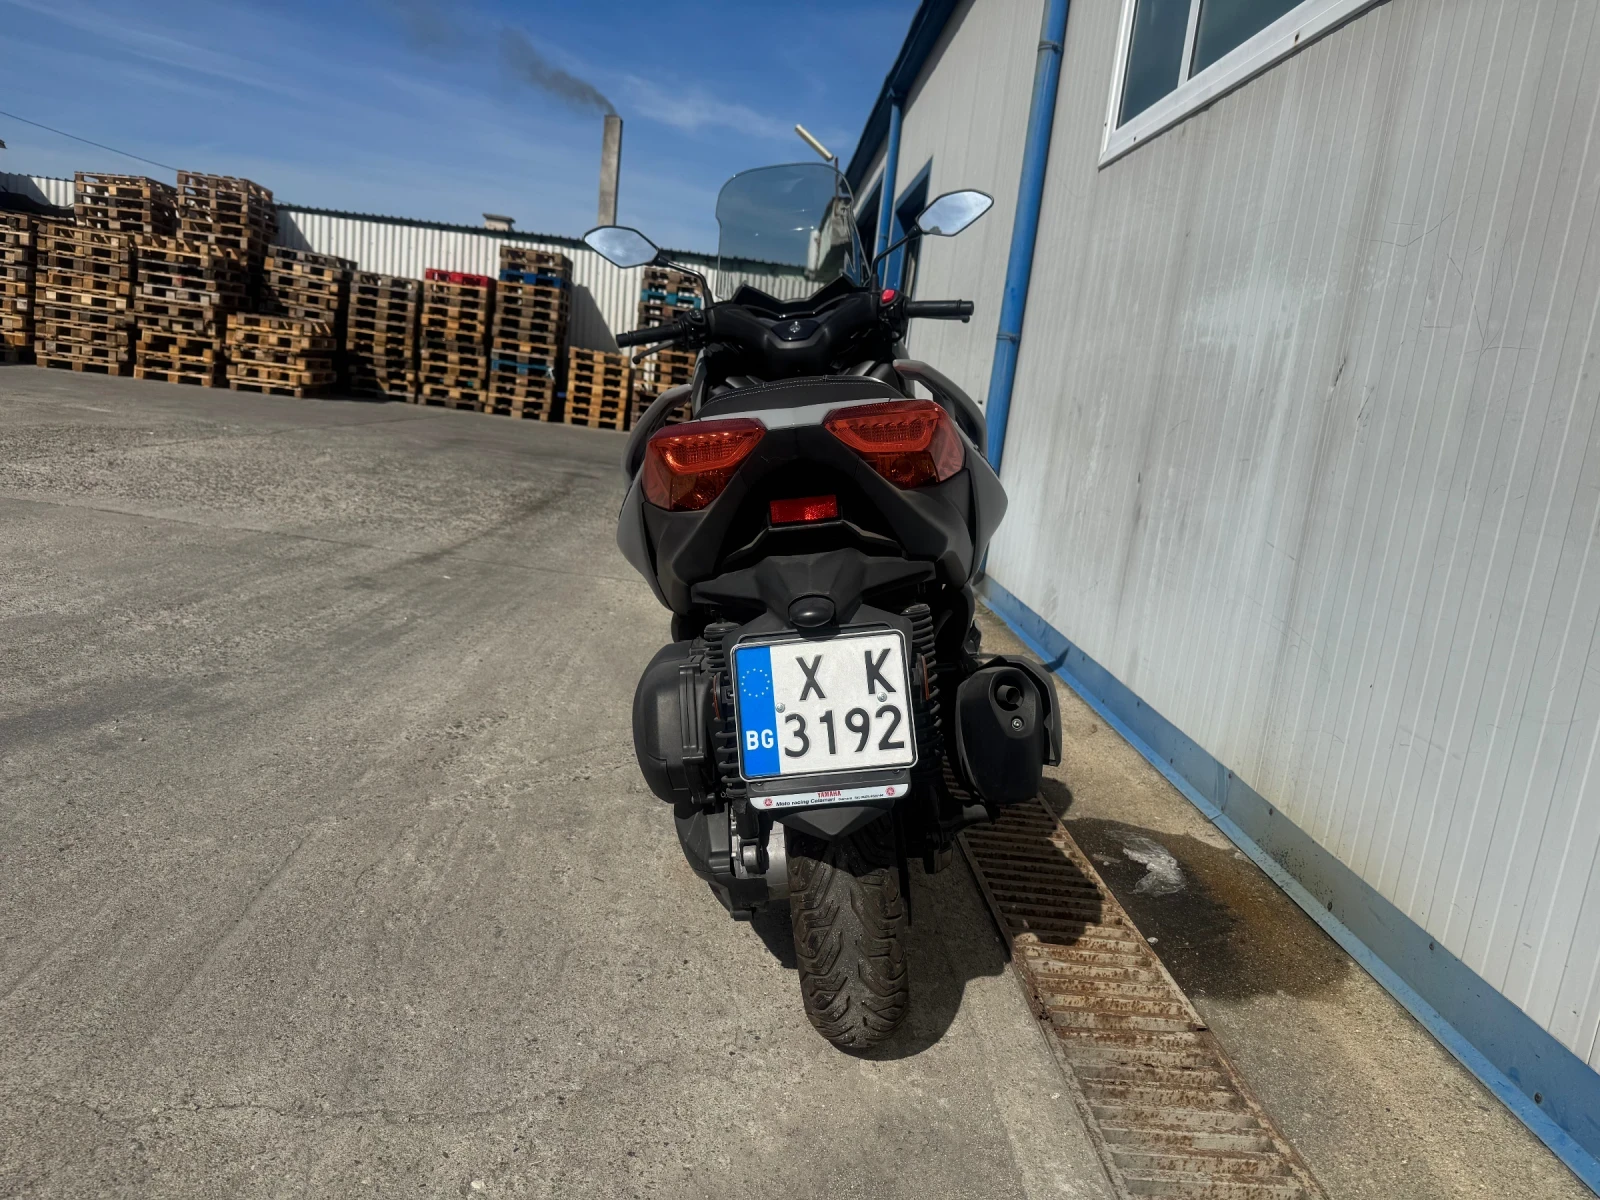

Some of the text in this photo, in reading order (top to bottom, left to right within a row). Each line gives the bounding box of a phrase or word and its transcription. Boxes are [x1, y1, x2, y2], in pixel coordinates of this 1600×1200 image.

[795, 648, 897, 702] X K
[745, 729, 774, 751] BG
[784, 704, 905, 758] 3192
[817, 790, 842, 798] YAMAHA
